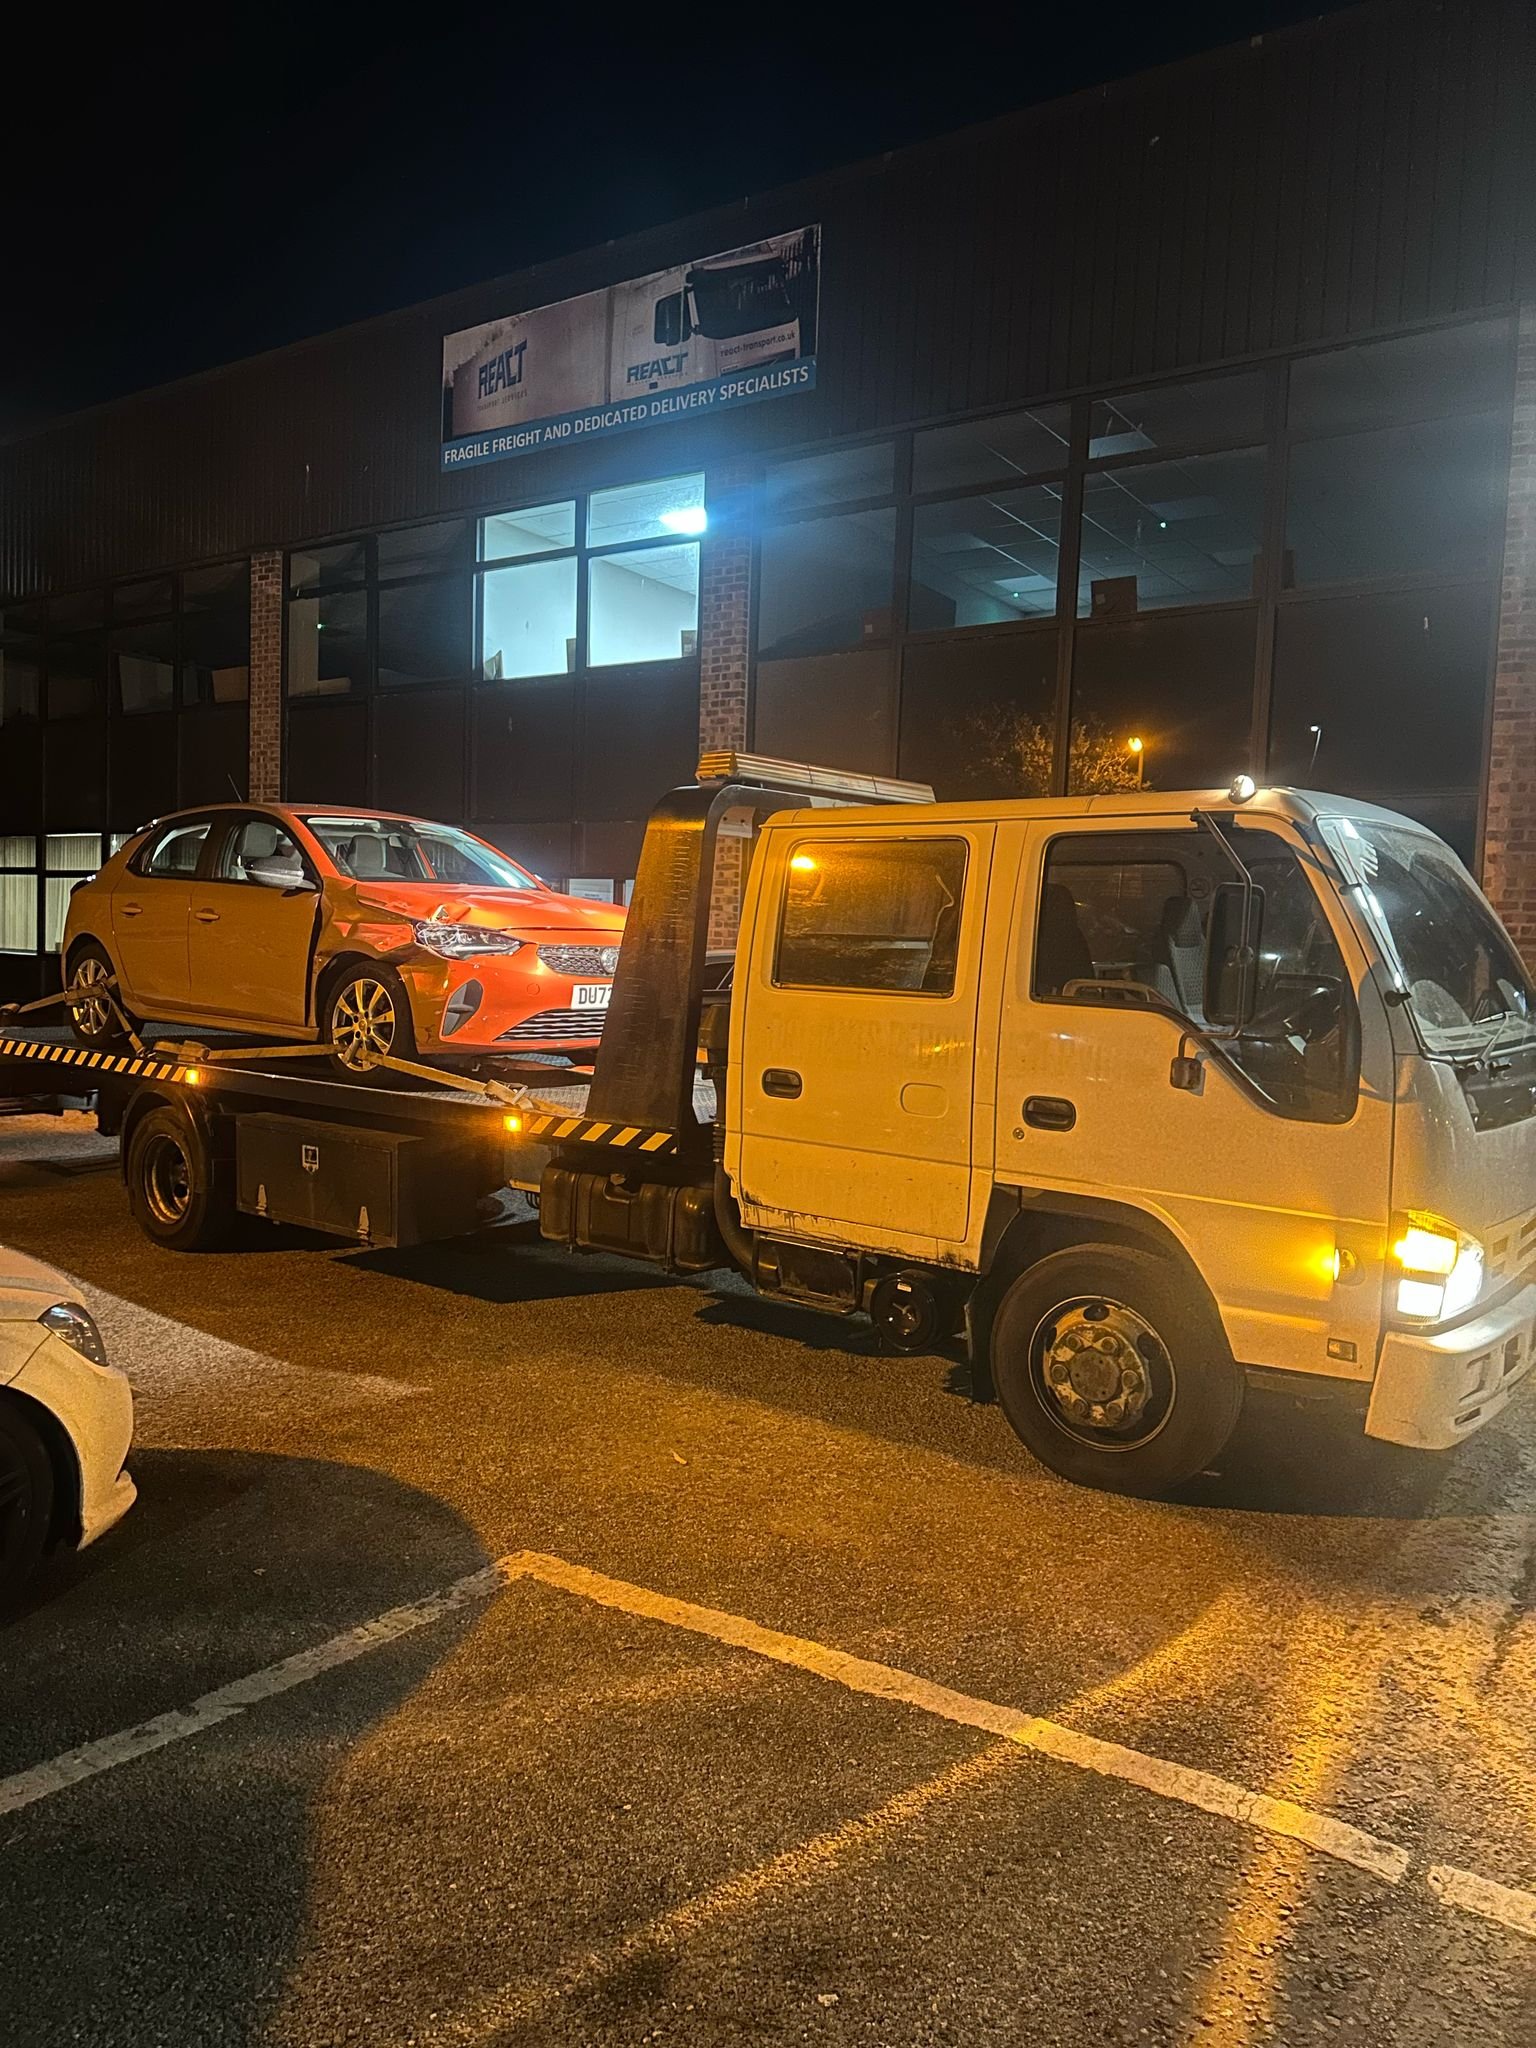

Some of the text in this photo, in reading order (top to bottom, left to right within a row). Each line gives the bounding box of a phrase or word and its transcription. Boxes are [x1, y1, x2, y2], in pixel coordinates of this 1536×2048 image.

[626, 352, 689, 384] REACT
[719, 332, 796, 358] react-transport.co.uk
[478, 338, 528, 400] REACT
[444, 441, 490, 464] FRAGILE
[492, 429, 542, 453] FREIGHT
[544, 422, 571, 441] AND
[574, 404, 647, 434] DEDICATED
[651, 388, 716, 417] DELIVERY
[719, 366, 809, 401] SPECIALISTS
